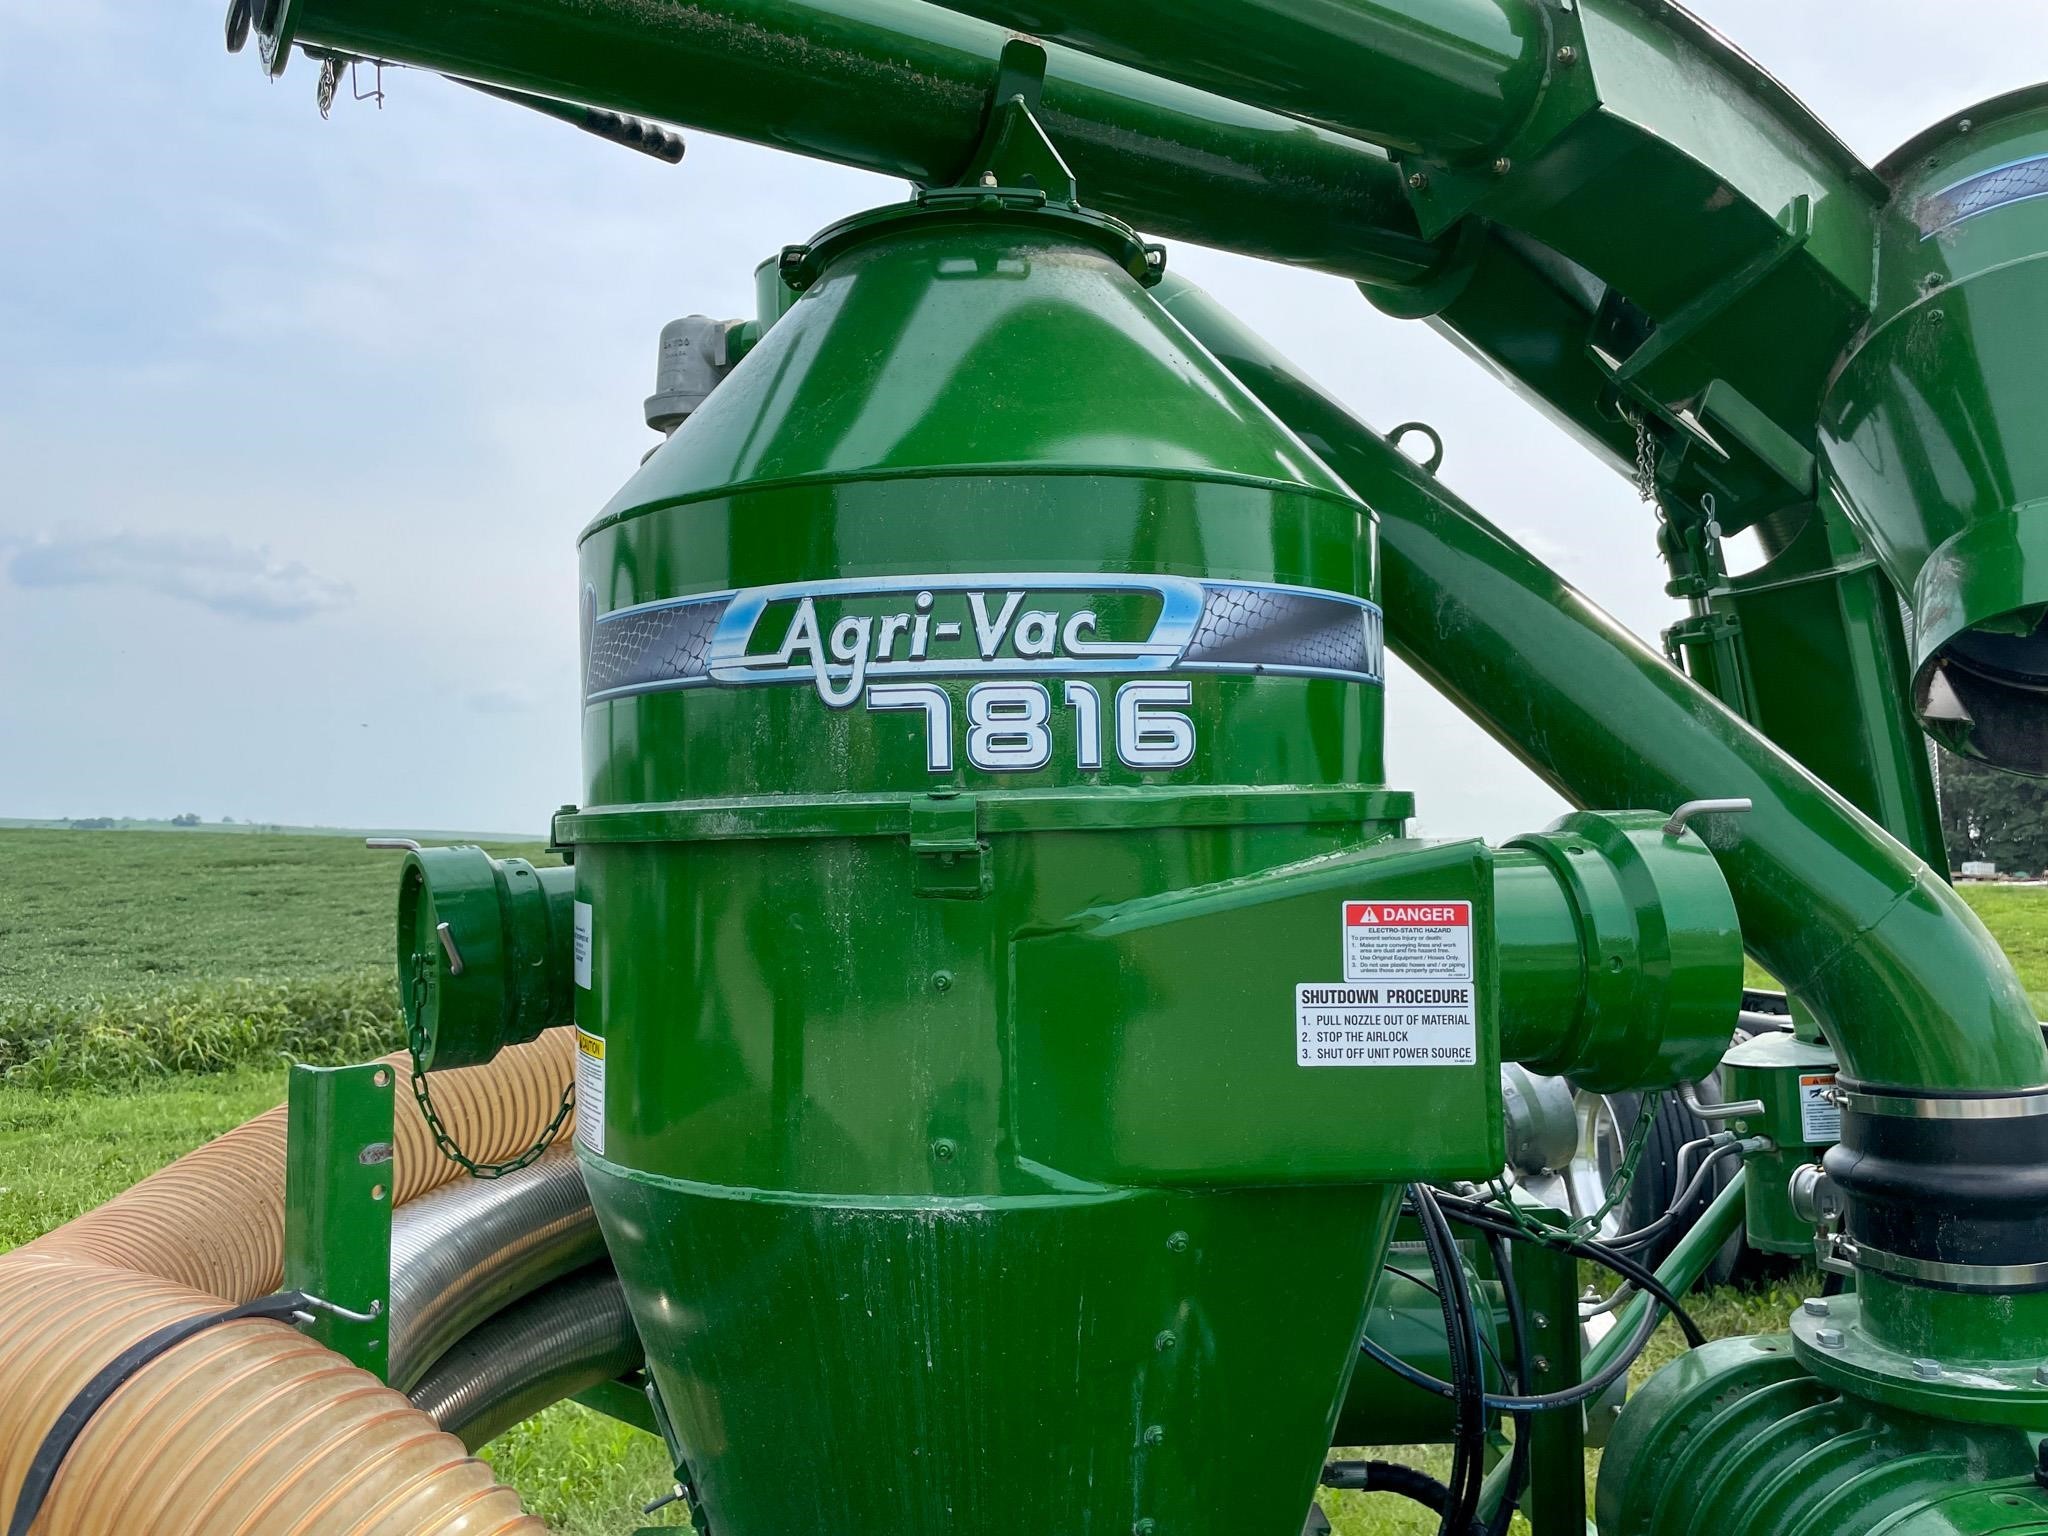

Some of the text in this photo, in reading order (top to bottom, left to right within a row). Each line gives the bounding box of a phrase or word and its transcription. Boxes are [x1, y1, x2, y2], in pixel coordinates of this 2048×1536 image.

[746, 591, 1108, 707] Agri-Vac
[866, 680, 1196, 772] 7816
[1383, 907, 1455, 922] DANGER
[1302, 989, 1468, 1003] SHUTDOWN PROCEDURE
[1302, 1015, 1470, 1025] 1. PULL NOZZLE OUT OF MATERIAL
[1302, 1032, 1408, 1042] 2. STOP THE AIRLOCK
[1302, 1048, 1471, 1059] 3. SHUT OFF UNIT POWER SOURCE
